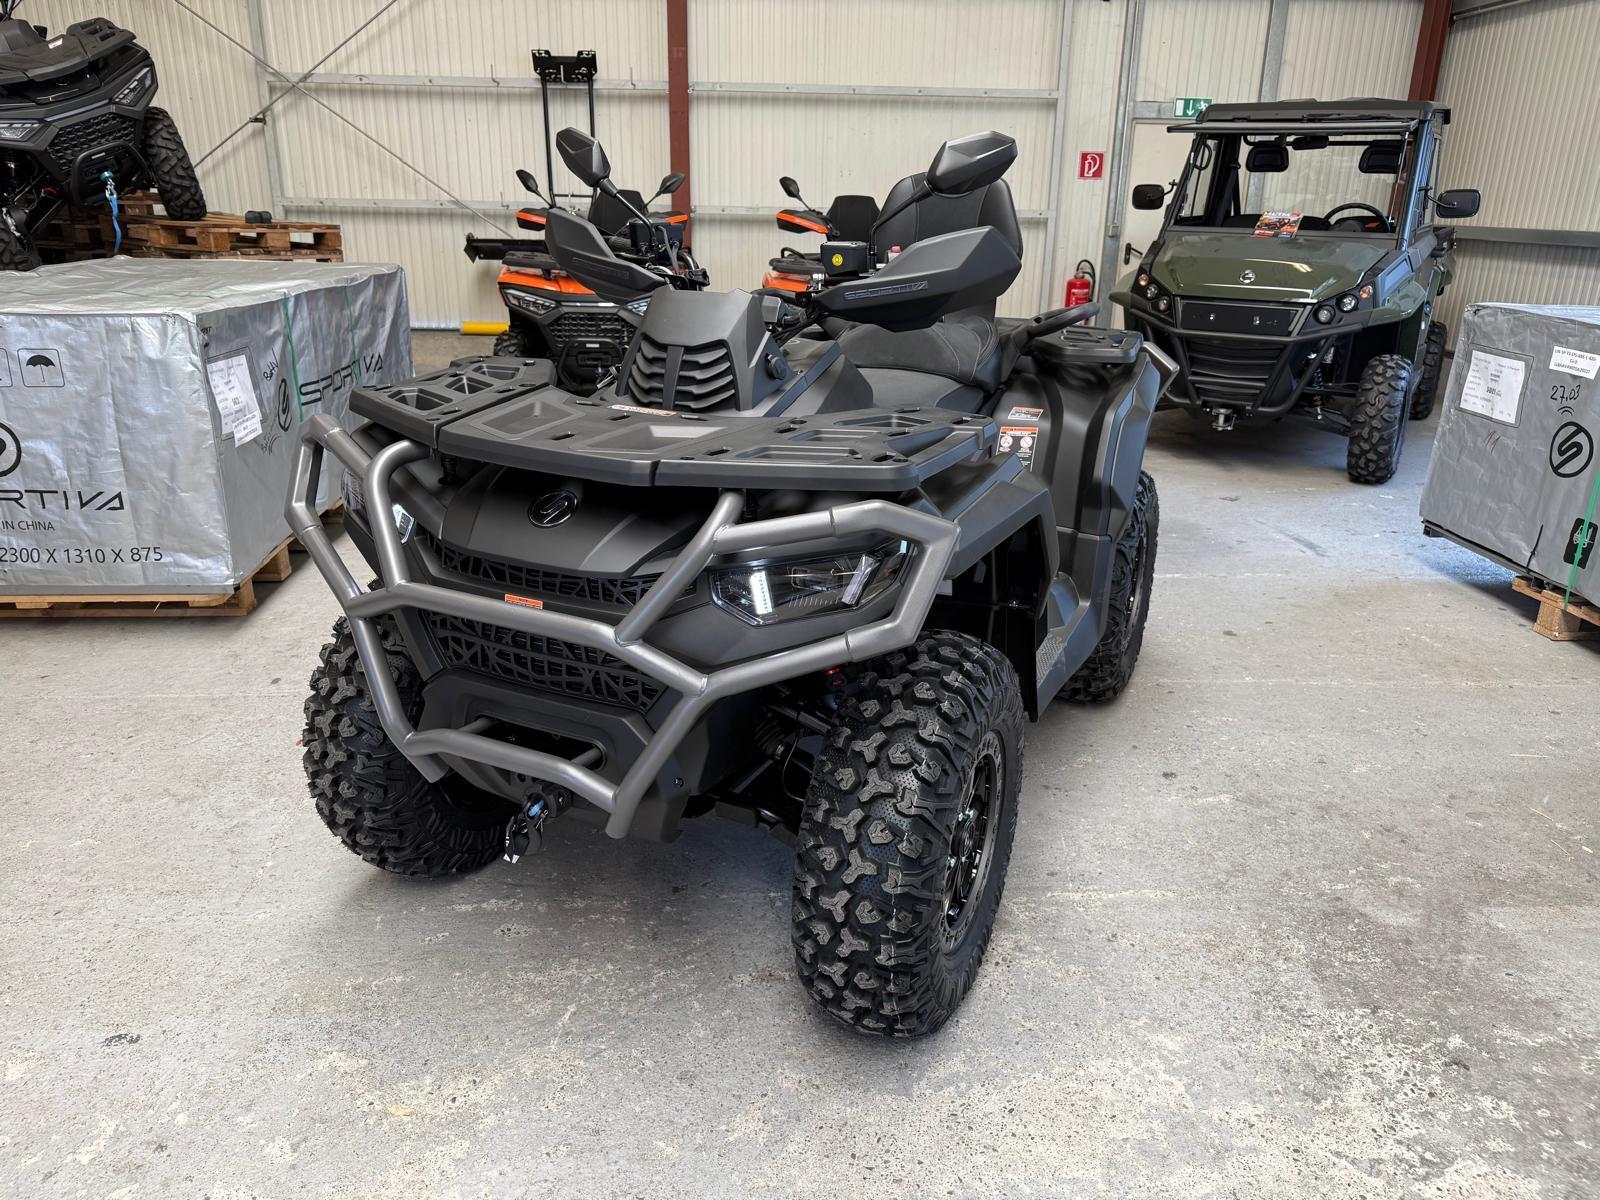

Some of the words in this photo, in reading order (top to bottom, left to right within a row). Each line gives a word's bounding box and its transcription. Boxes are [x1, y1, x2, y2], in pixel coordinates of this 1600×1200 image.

[299, 352, 383, 406] SPORTIVA
[2, 520, 15, 530] IN
[18, 520, 55, 531] CHINA
[0, 547, 41, 563] 2300
[64, 548, 106, 564] 1310
[130, 546, 163, 562] 875
